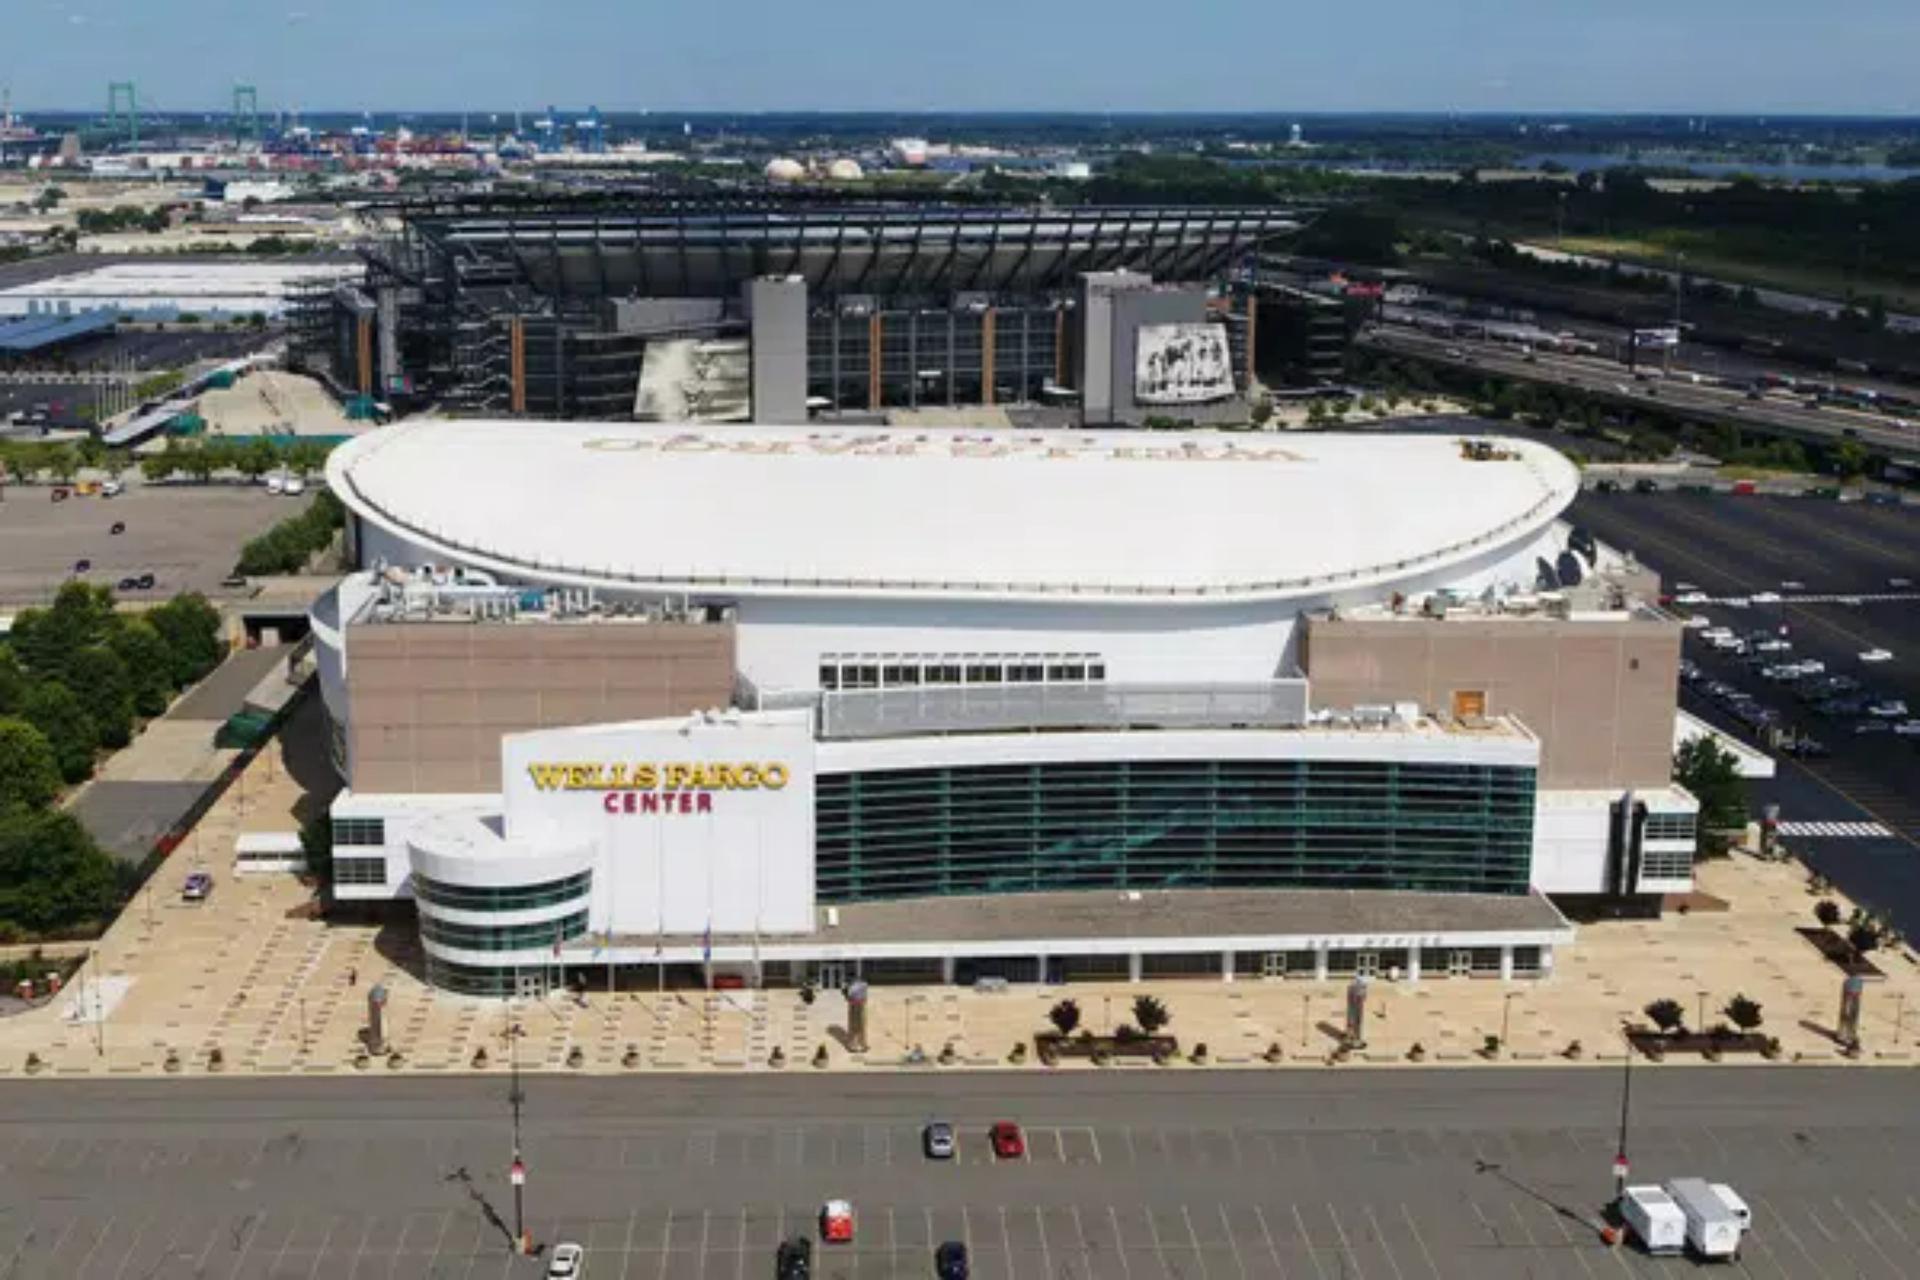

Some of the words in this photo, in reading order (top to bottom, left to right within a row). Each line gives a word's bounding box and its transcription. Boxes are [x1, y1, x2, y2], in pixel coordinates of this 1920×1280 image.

[529, 762, 658, 791] WELLS
[664, 762, 790, 791] FARGO
[604, 793, 712, 814] CENTER
